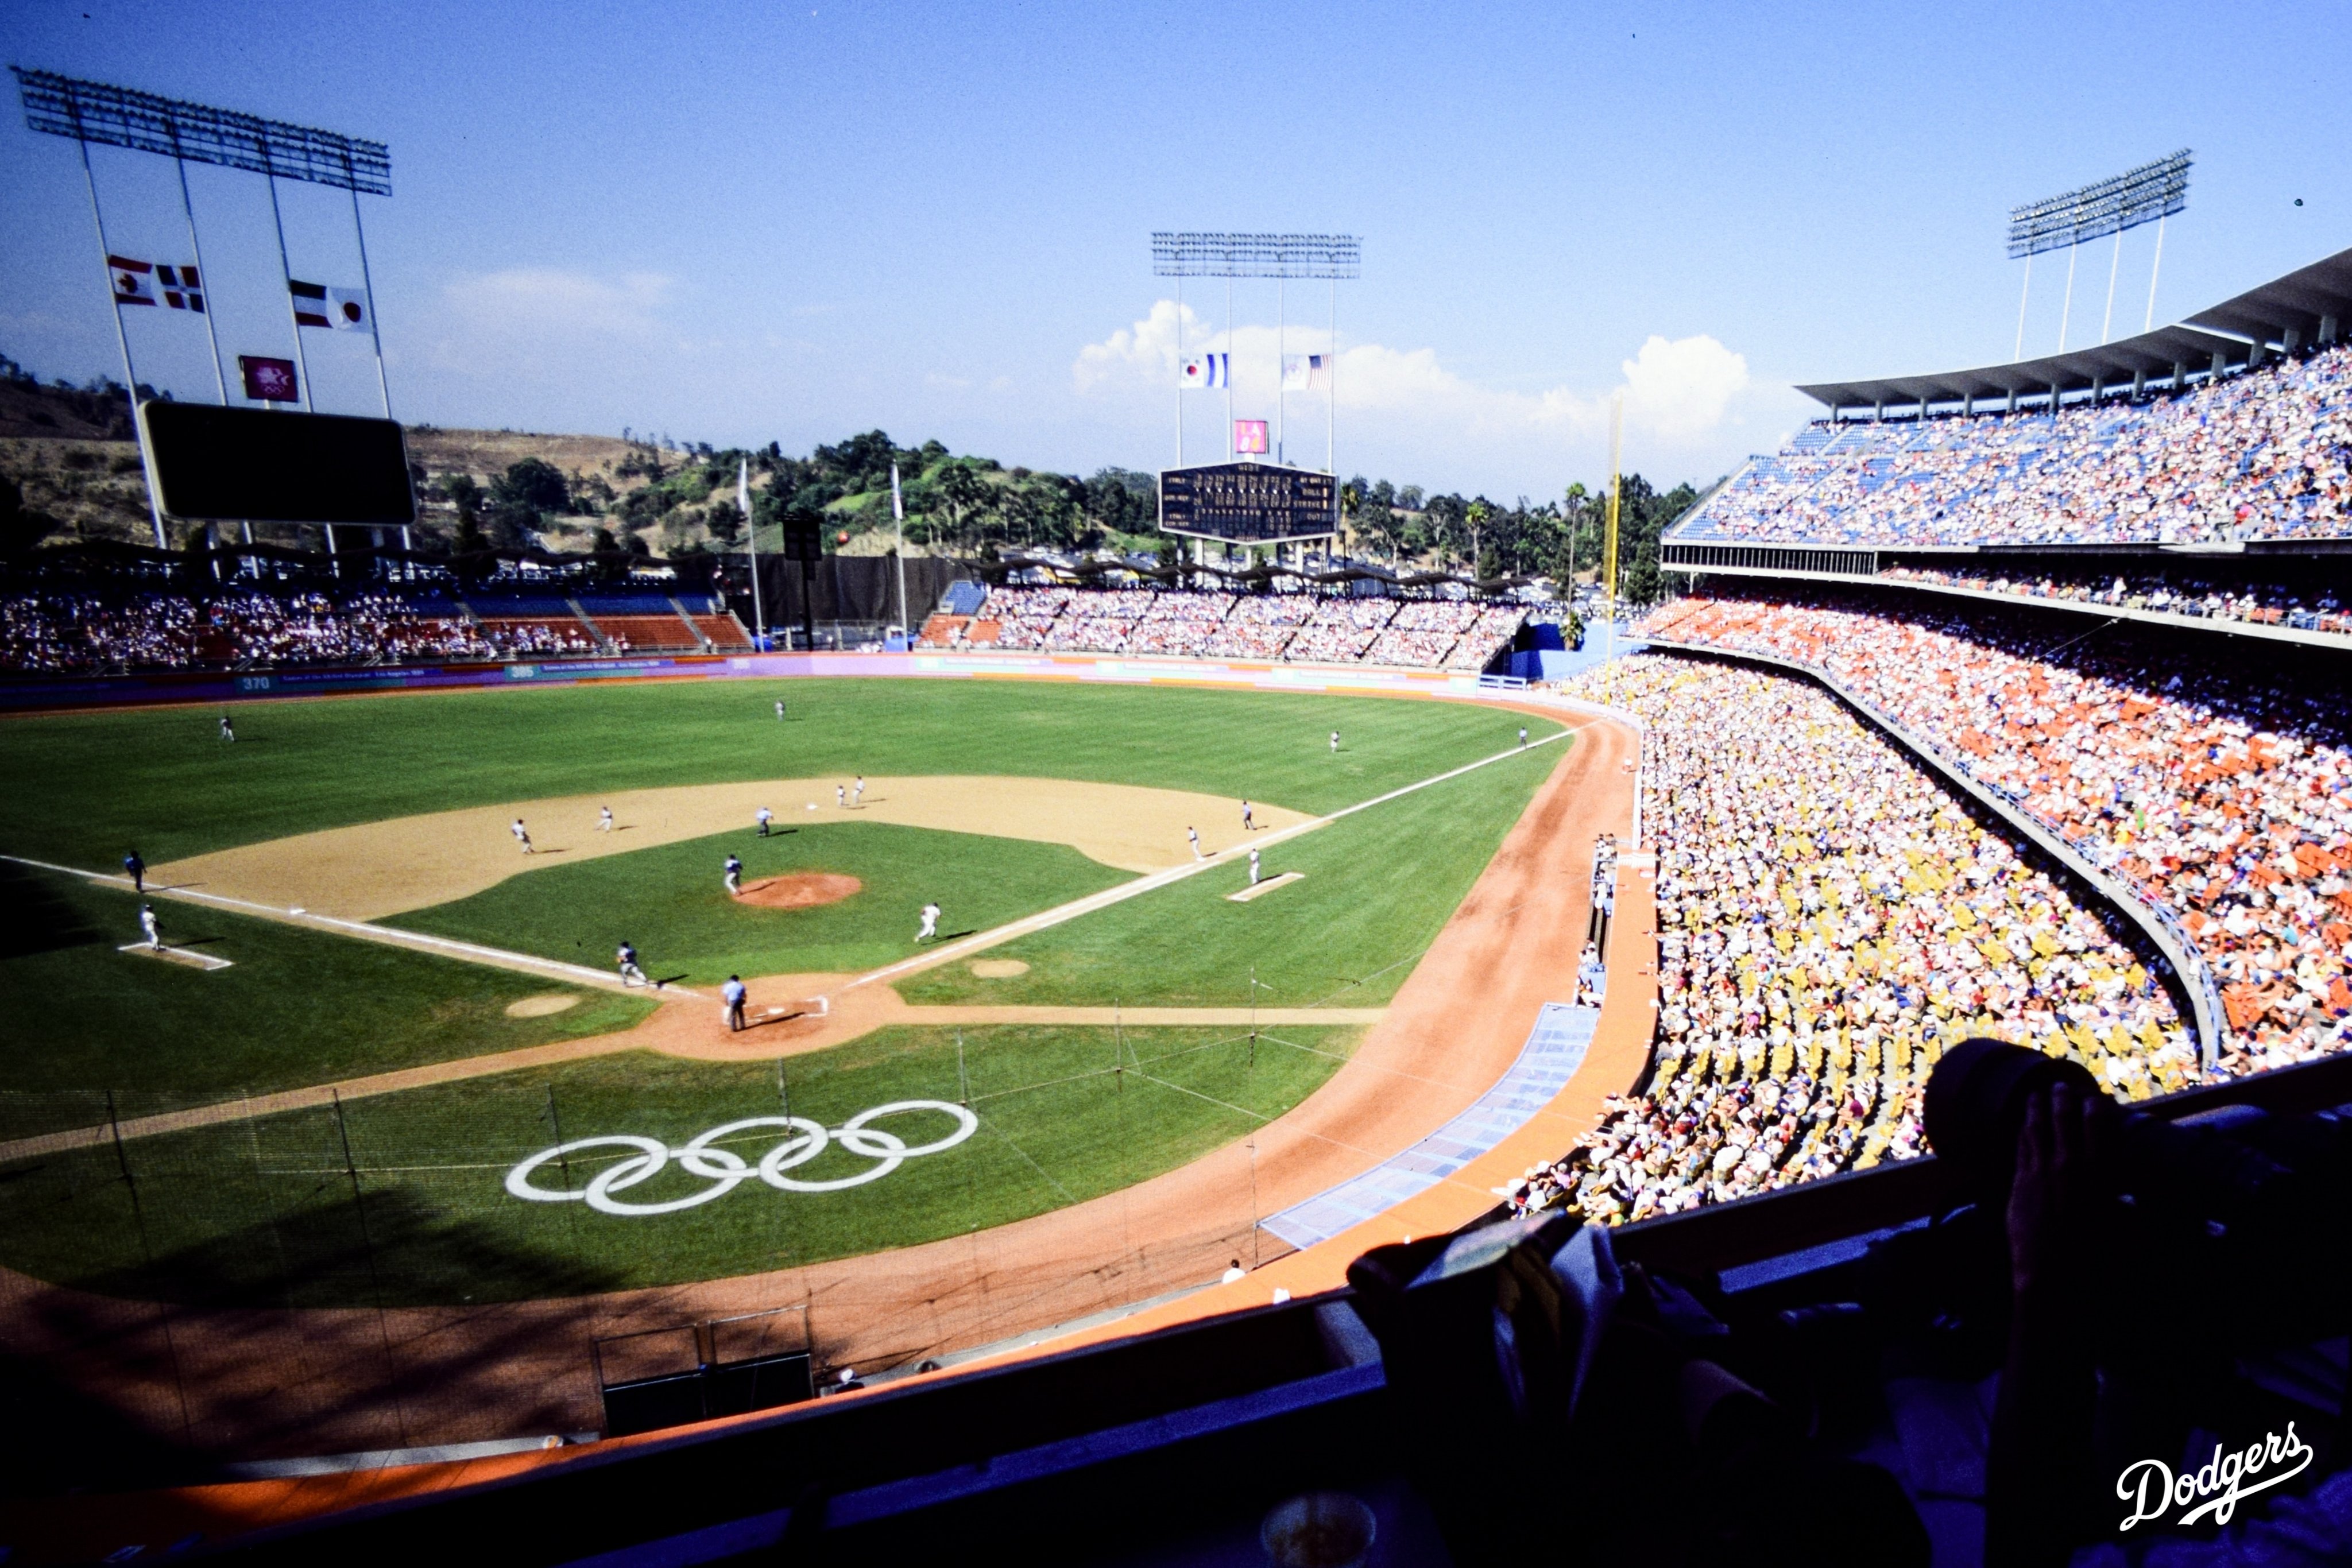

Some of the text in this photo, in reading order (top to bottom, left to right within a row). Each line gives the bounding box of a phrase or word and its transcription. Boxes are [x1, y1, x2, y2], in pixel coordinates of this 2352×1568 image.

[1302, 487, 1321, 496] BALL
[1293, 500, 1321, 508] STRIKE
[243, 676, 270, 690] 370
